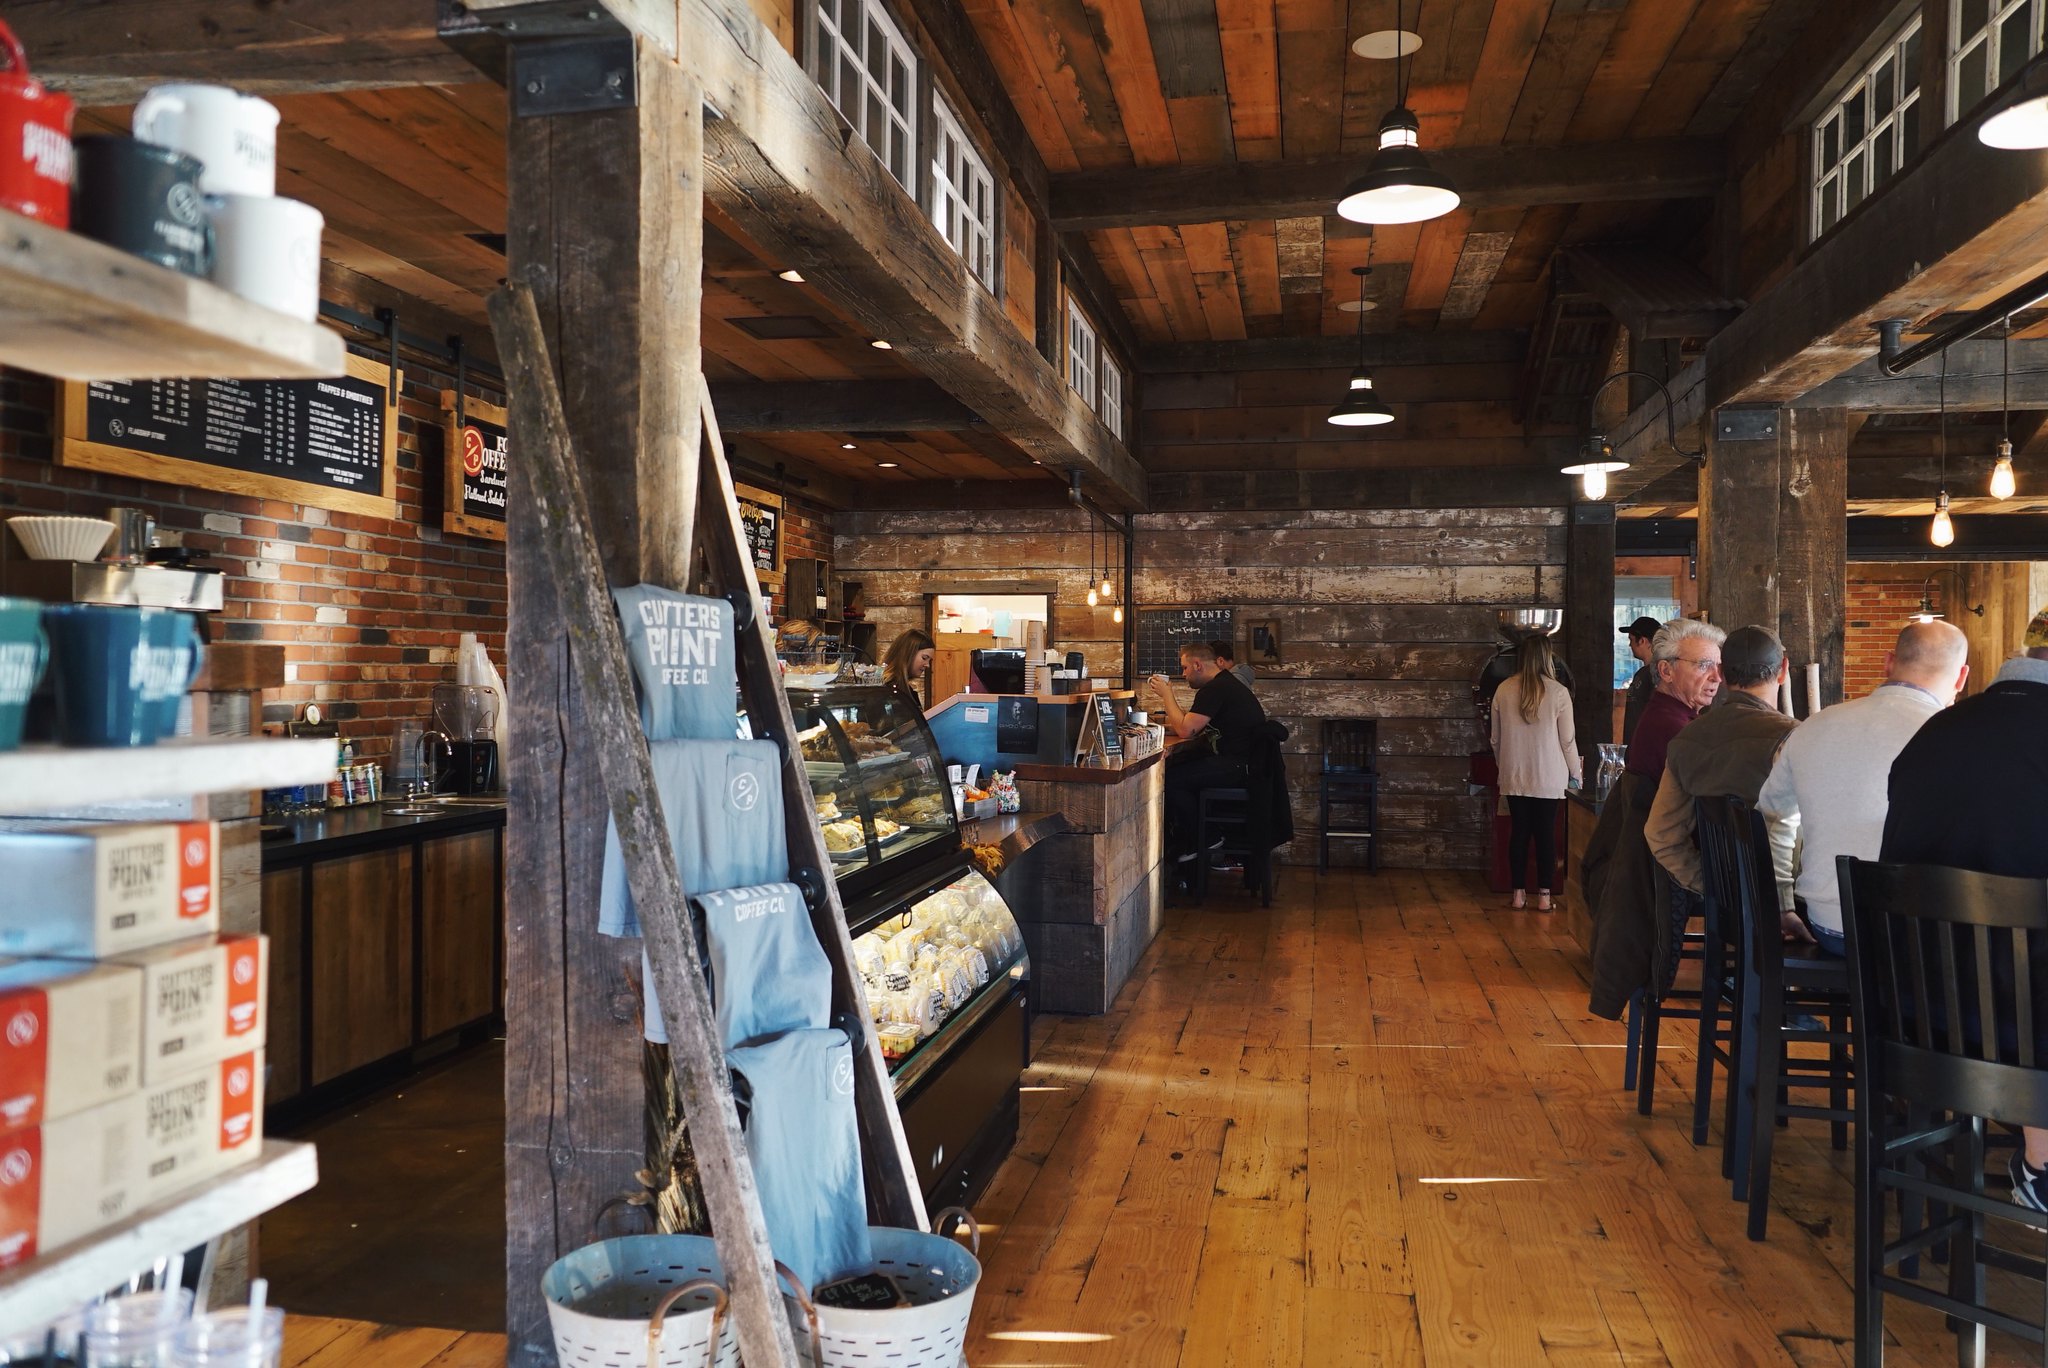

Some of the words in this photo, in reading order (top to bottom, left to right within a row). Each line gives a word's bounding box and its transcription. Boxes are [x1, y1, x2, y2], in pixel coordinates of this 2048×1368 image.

[317, 382, 341, 397] FRAPPES
[345, 389, 374, 406] SMOOTHIES
[487, 489, 505, 508] Salads
[639, 600, 720, 630] CUTTERS
[1184, 610, 1231, 619] EVENTS
[646, 628, 721, 666] POINT
[734, 900, 768, 922] COFFEE
